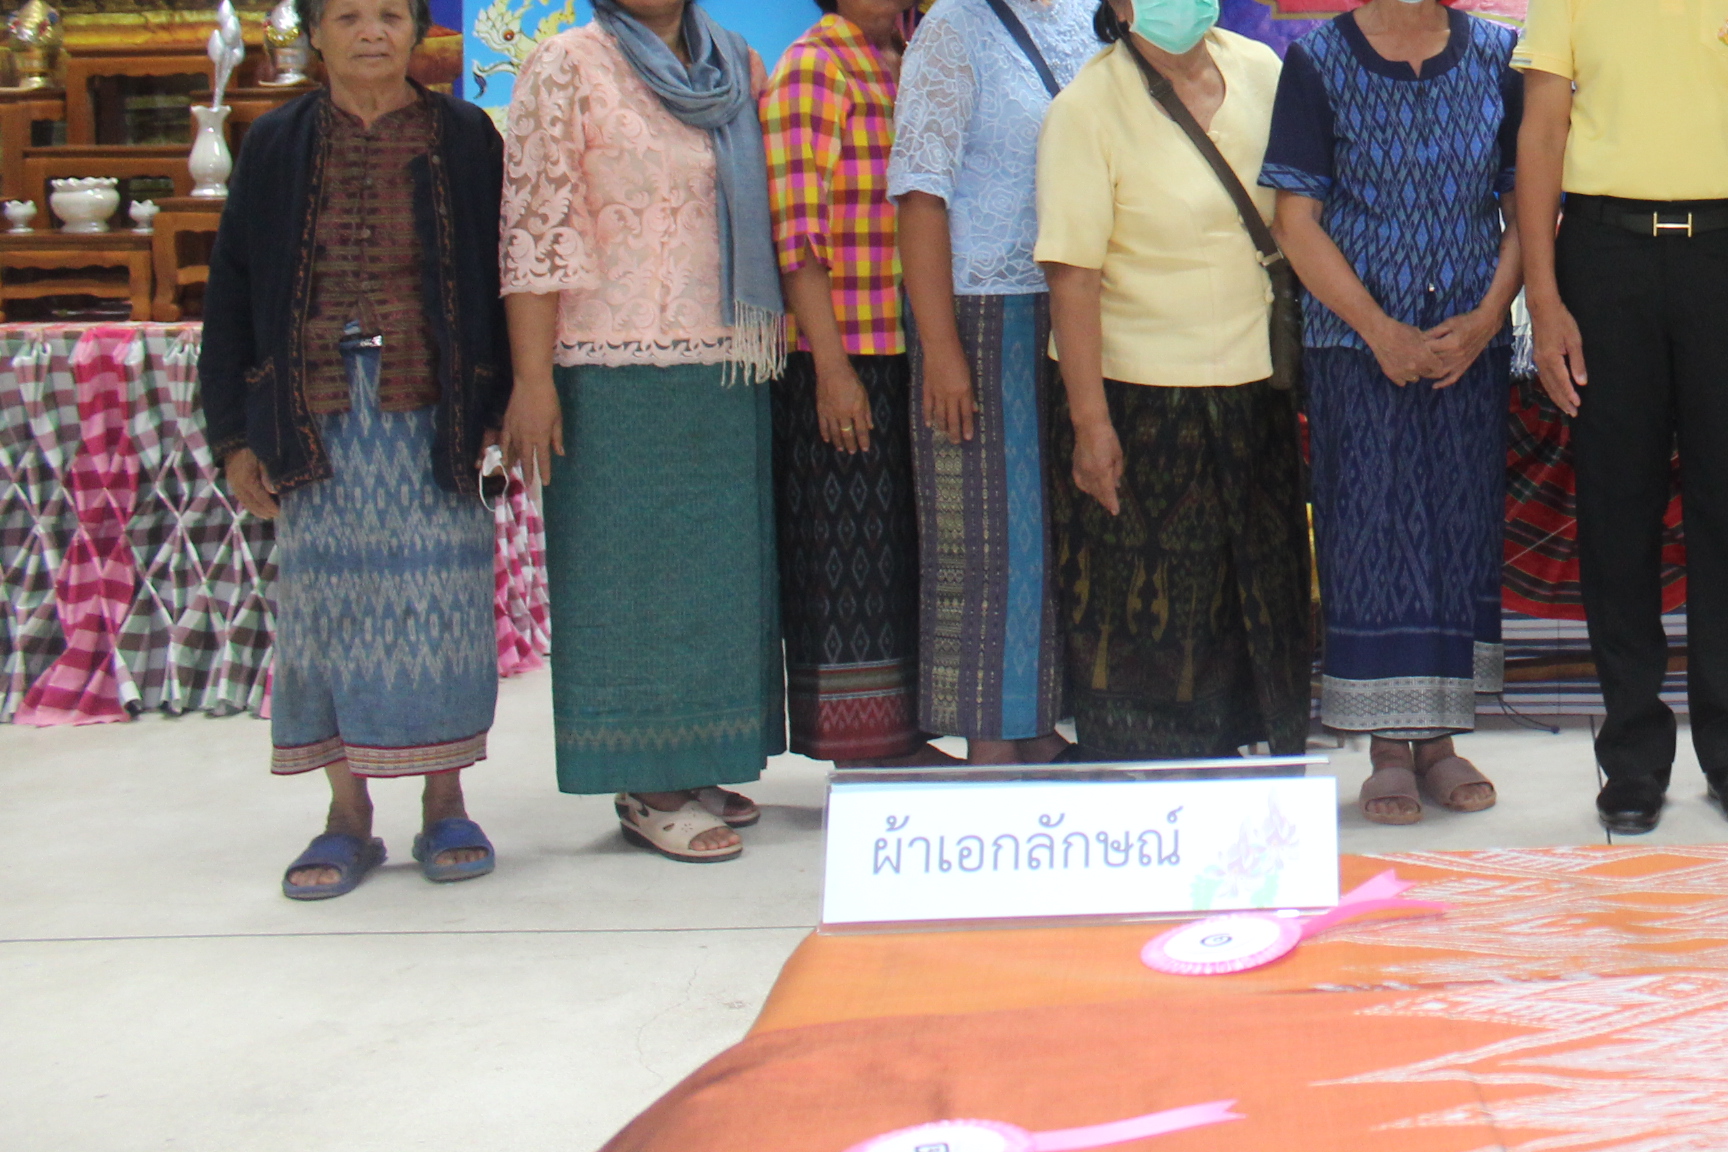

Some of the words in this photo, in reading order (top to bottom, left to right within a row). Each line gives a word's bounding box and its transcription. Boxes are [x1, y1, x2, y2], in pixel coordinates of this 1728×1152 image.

[872, 805, 1184, 875] ผ้าเอกลักษณ์
